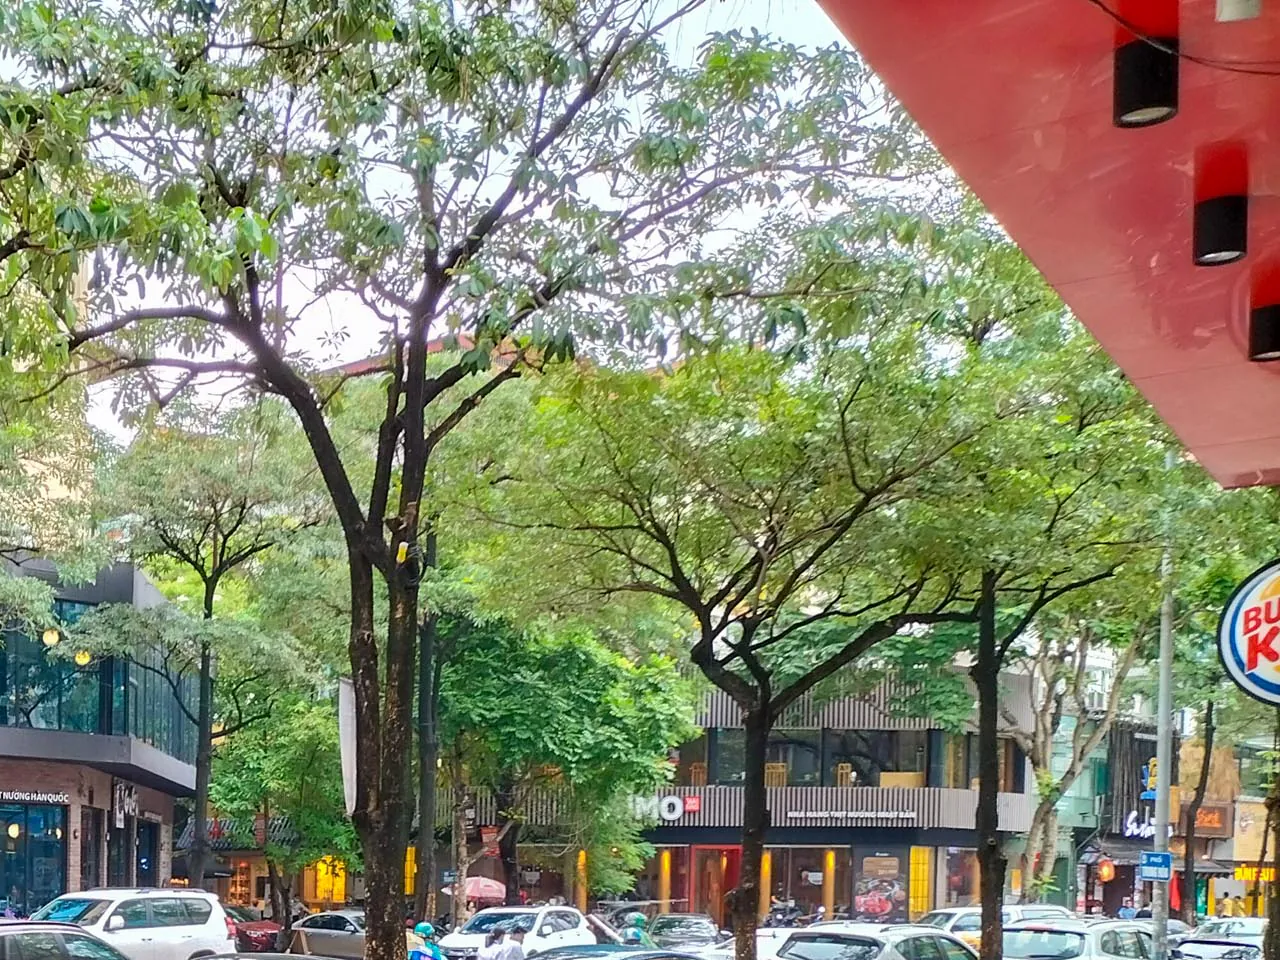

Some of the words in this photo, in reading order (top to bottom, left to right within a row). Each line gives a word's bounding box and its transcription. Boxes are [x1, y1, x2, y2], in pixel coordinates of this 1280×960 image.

[3, 788, 30, 801] NƯỚNG
[31, 790, 48, 801] HÀN
[47, 791, 69, 803] QUỐC
